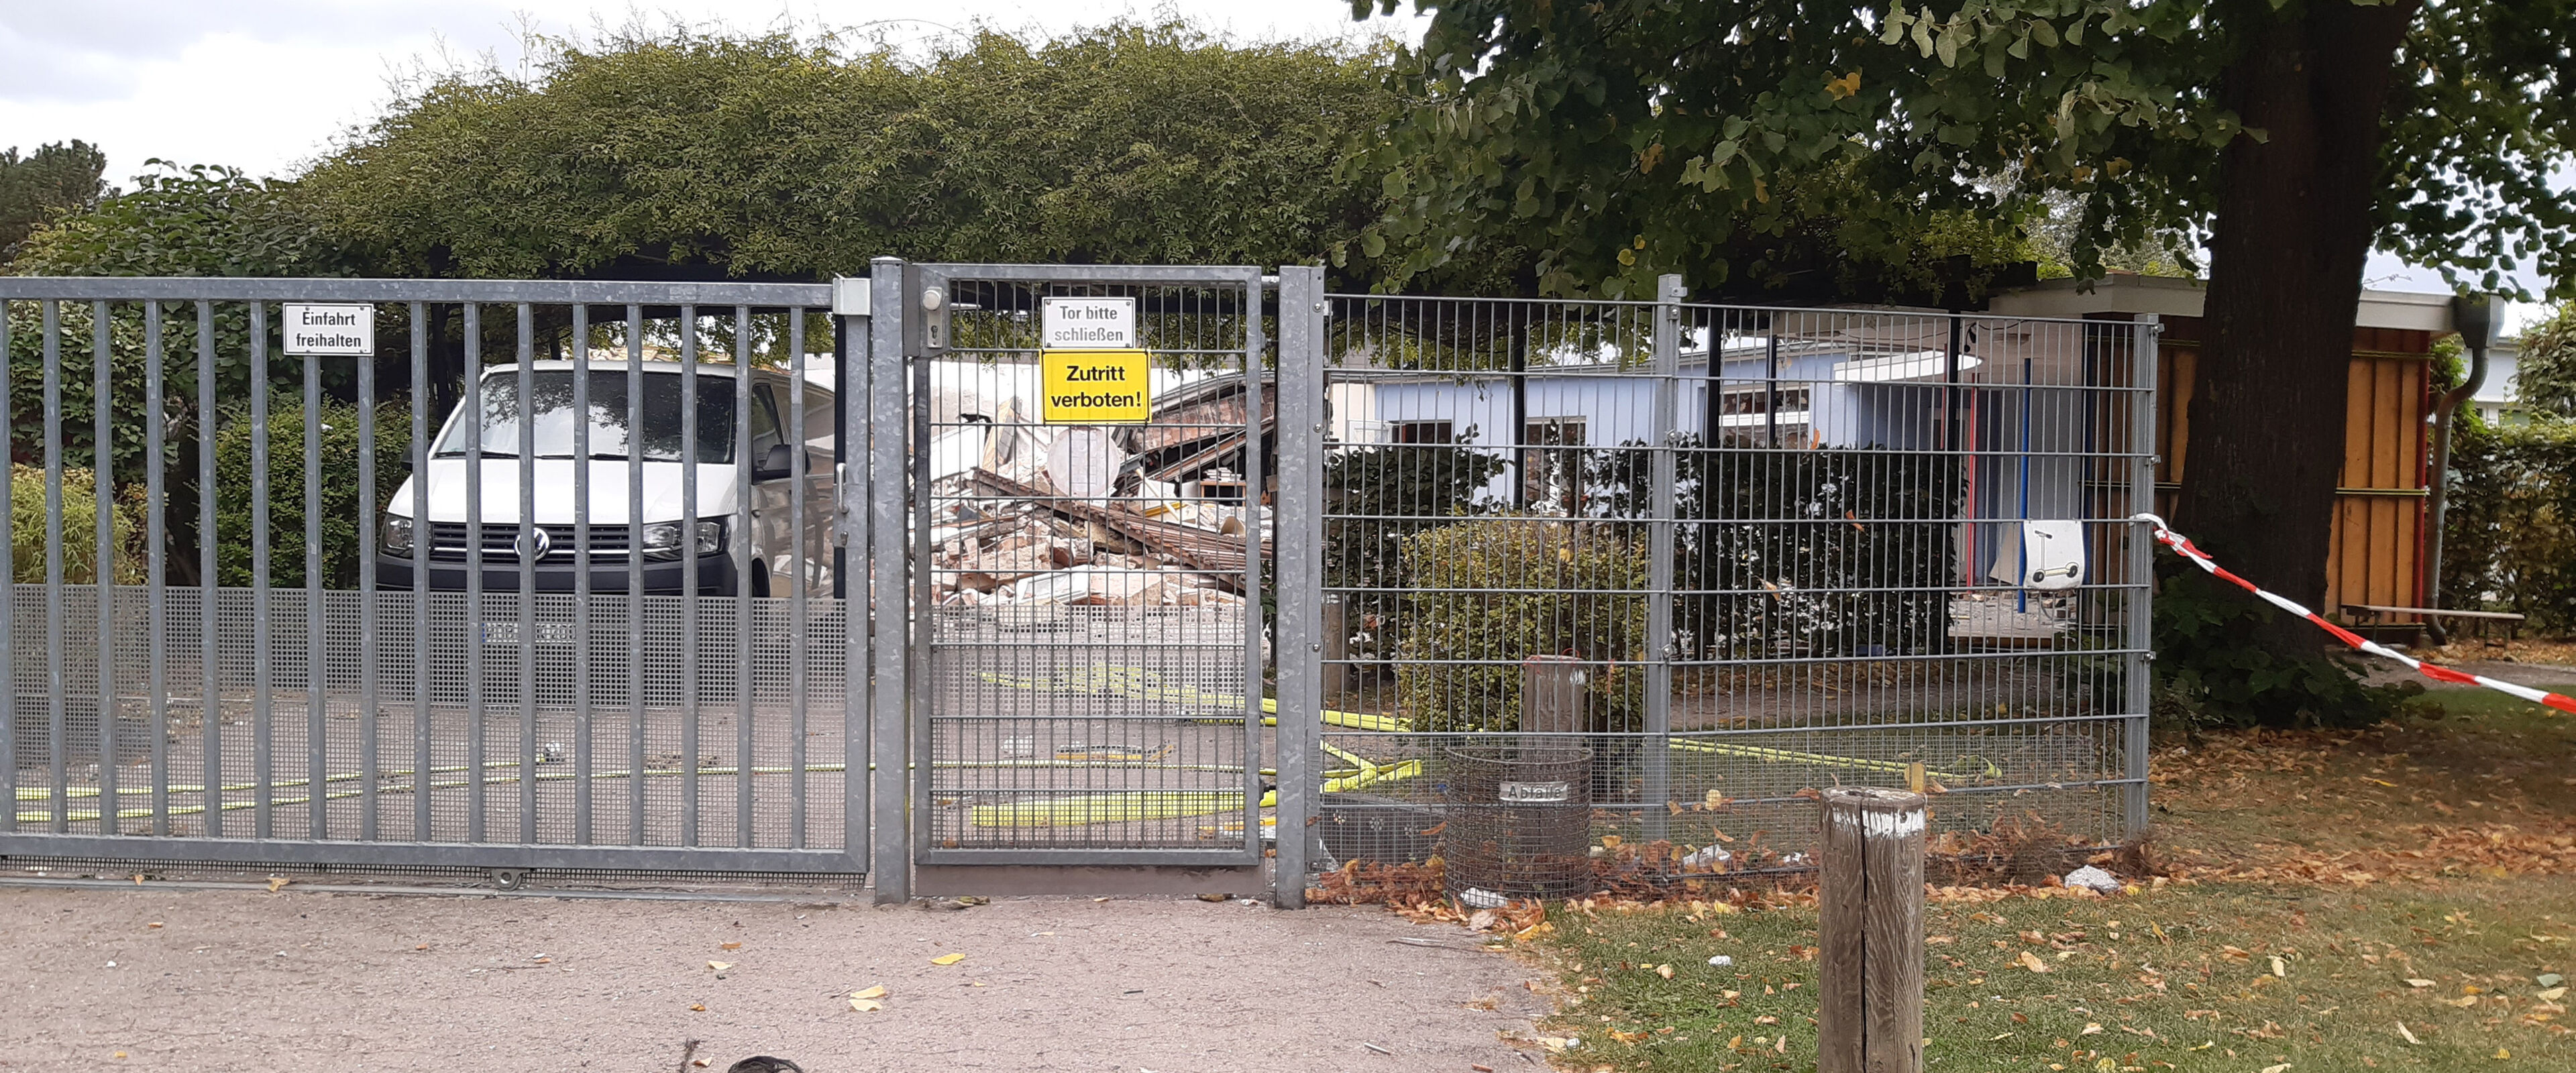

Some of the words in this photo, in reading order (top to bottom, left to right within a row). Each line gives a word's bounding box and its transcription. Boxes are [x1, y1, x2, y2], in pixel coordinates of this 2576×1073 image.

[303, 312, 356, 325] Einfahrt
[1059, 306, 1081, 320] Tor
[1085, 306, 1118, 320] bitte
[296, 333, 362, 347] freihalten
[1054, 327, 1123, 341] schließen
[1066, 365, 1126, 381] Zutritt
[1051, 392, 1141, 408] verboten!
[1508, 784, 1562, 799] Abfälle
